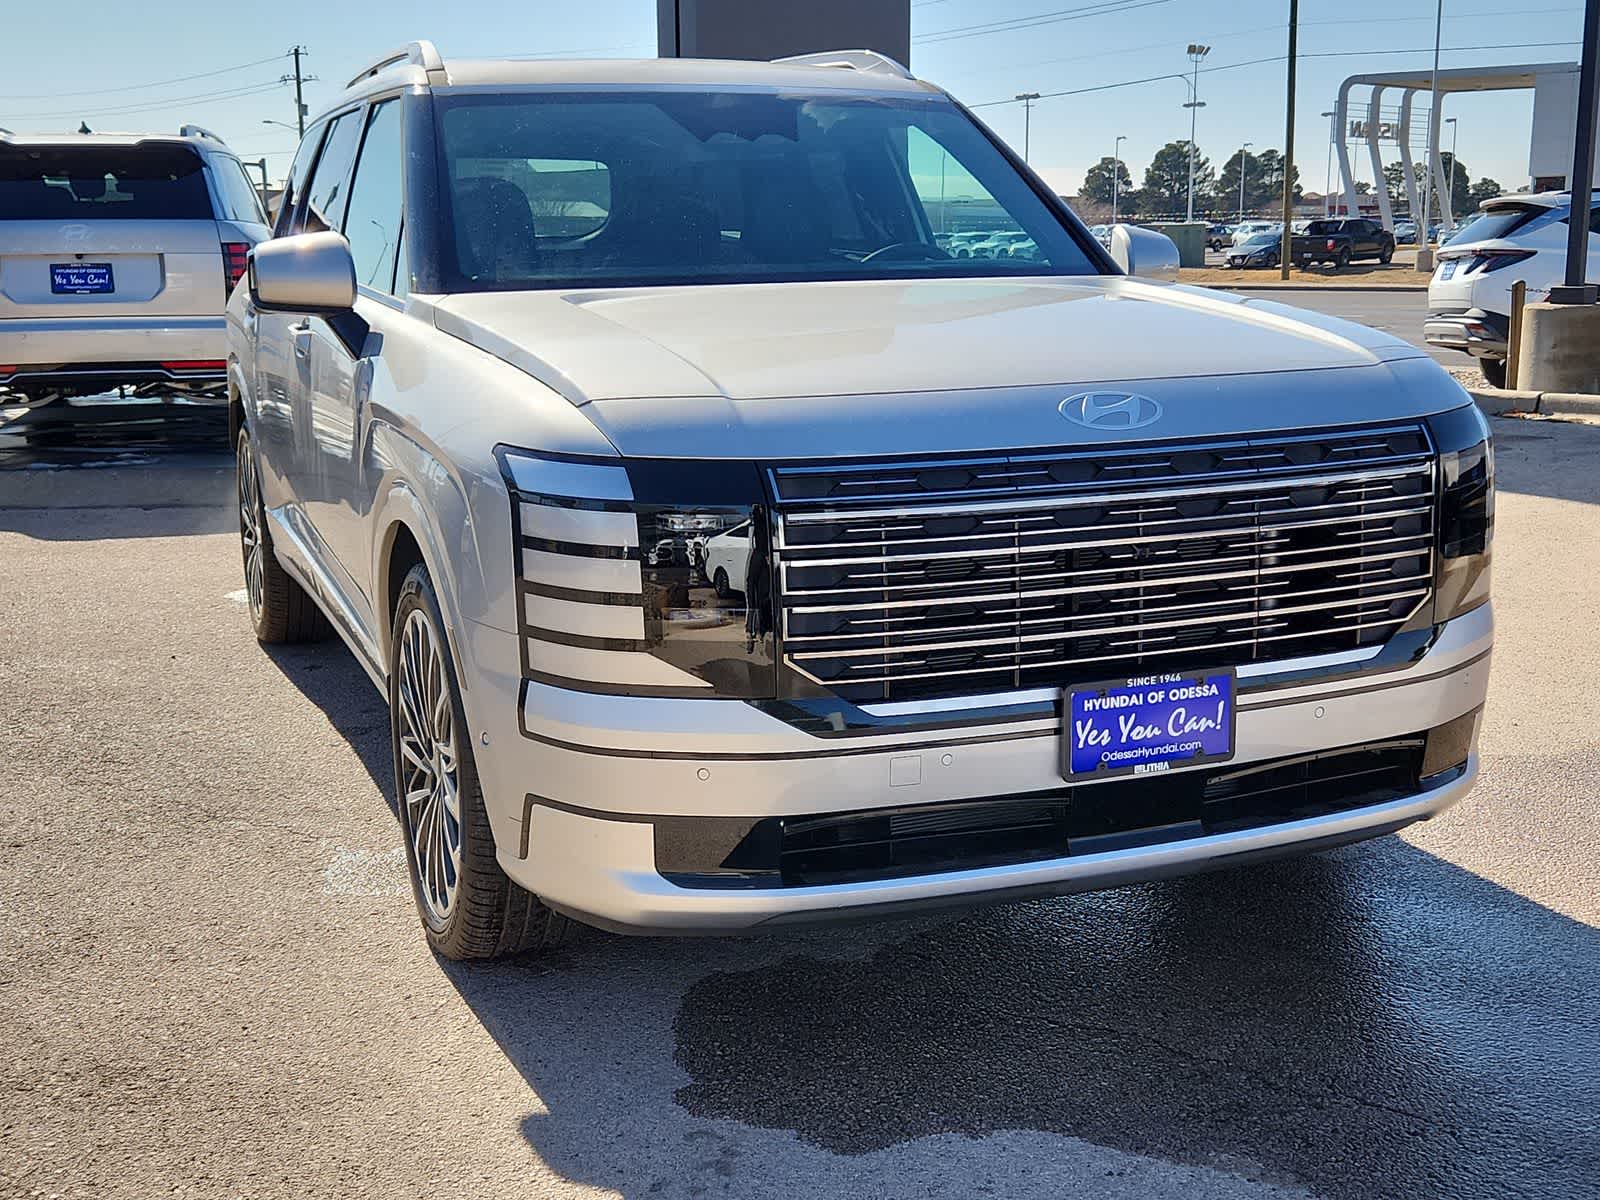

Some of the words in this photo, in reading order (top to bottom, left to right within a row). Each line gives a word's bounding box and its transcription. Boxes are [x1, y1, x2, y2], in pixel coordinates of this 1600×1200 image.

[70, 274, 85, 284] You
[88, 274, 108, 284] Can!
[1127, 675, 1157, 688] SINCE
[1159, 672, 1182, 684] 1946
[1084, 693, 1143, 712] HYUNDAI
[1147, 690, 1165, 704] OF
[1168, 684, 1219, 701] ODESSA
[1075, 718, 1112, 749] Yes
[1118, 713, 1162, 743] You
[1167, 700, 1225, 737] Can!
[1101, 740, 1202, 762] OdessaHyundai.com
